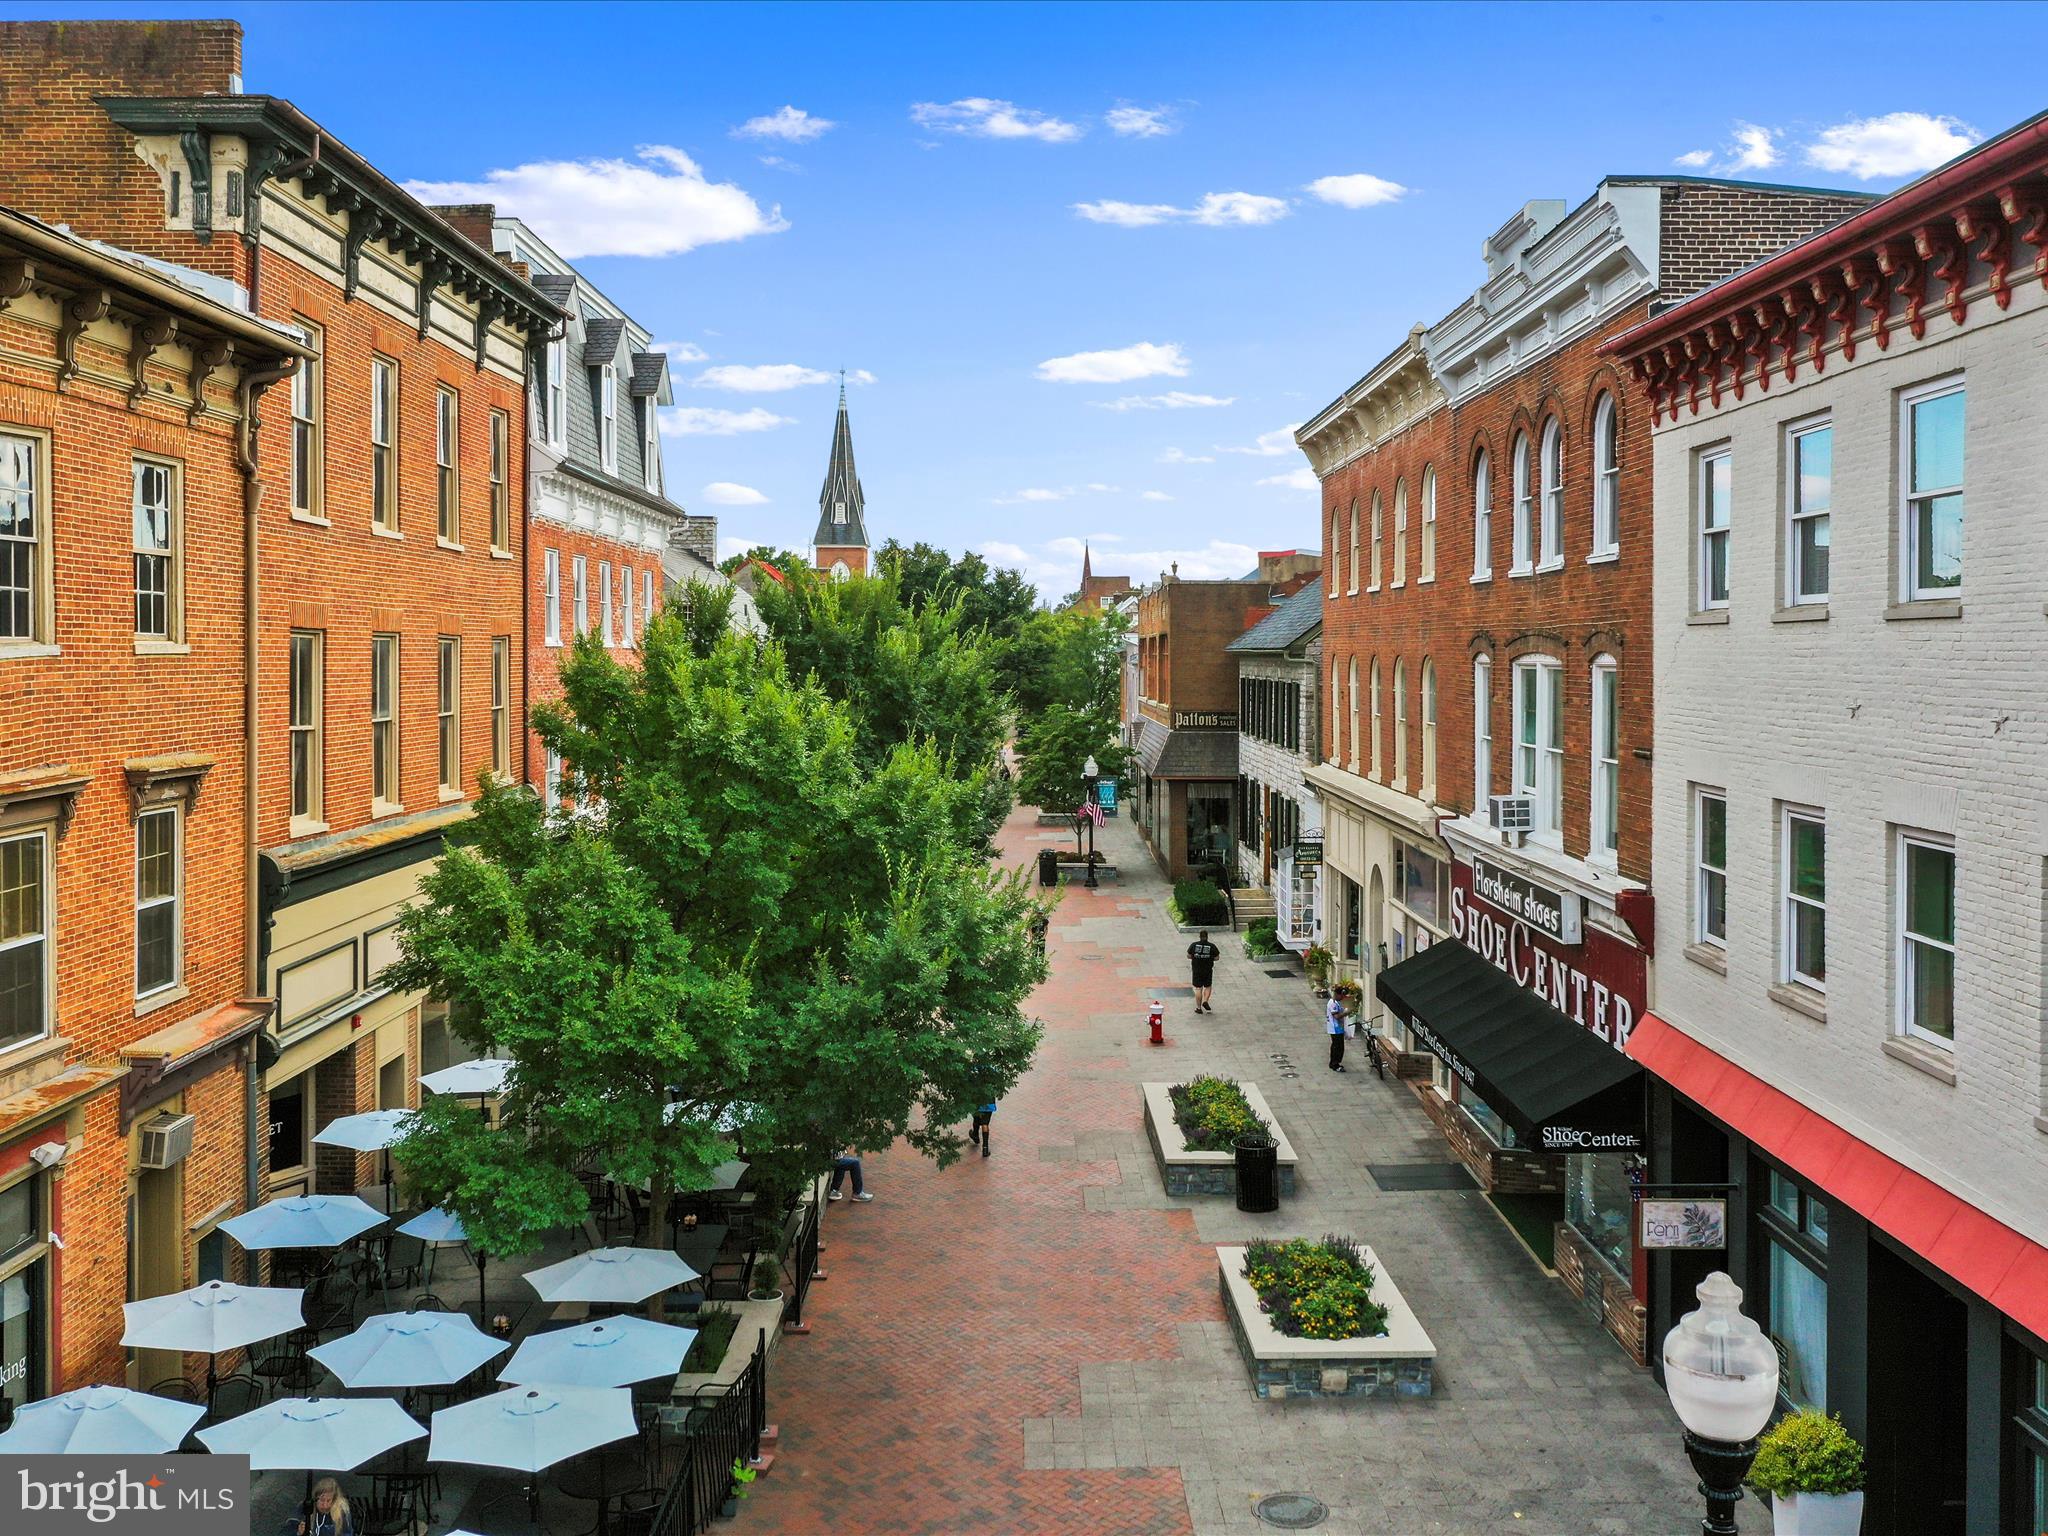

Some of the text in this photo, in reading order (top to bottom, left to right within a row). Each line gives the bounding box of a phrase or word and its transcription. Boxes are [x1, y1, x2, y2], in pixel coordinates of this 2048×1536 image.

[1475, 861, 1560, 932] Florsheim shoes
[1646, 1221, 1680, 1237] Fern
